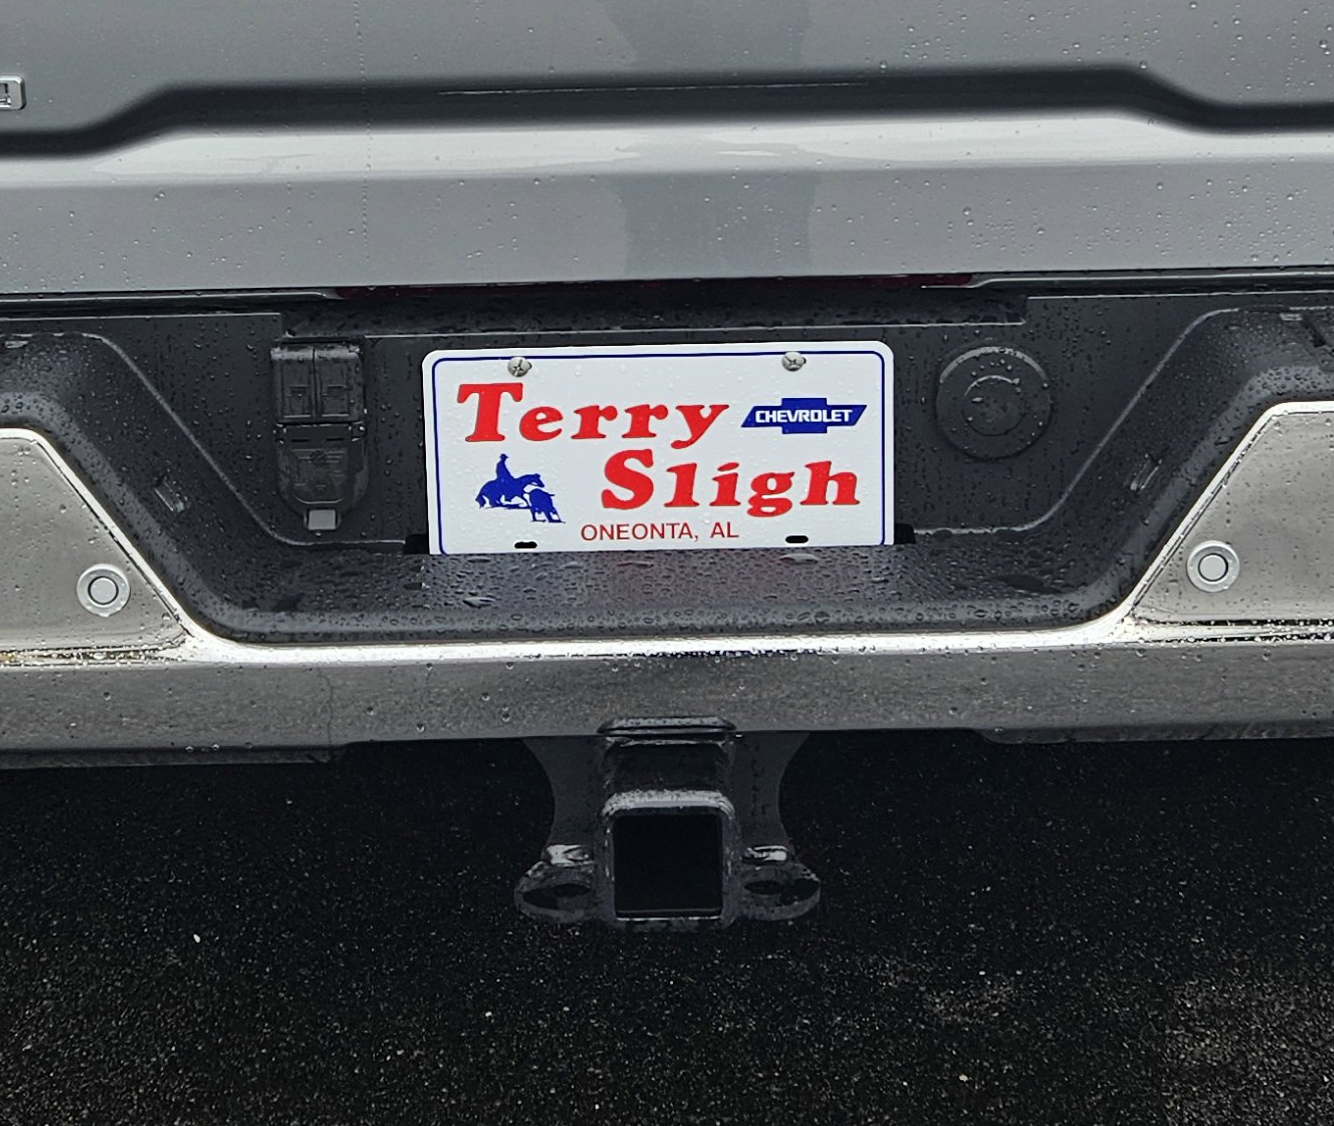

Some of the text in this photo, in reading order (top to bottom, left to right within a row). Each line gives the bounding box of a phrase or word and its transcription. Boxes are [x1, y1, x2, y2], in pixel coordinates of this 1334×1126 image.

[456, 382, 854, 451] Terry CHEVROLET
[601, 449, 861, 518] Sligh
[579, 521, 740, 543] ONEONTA, AL
